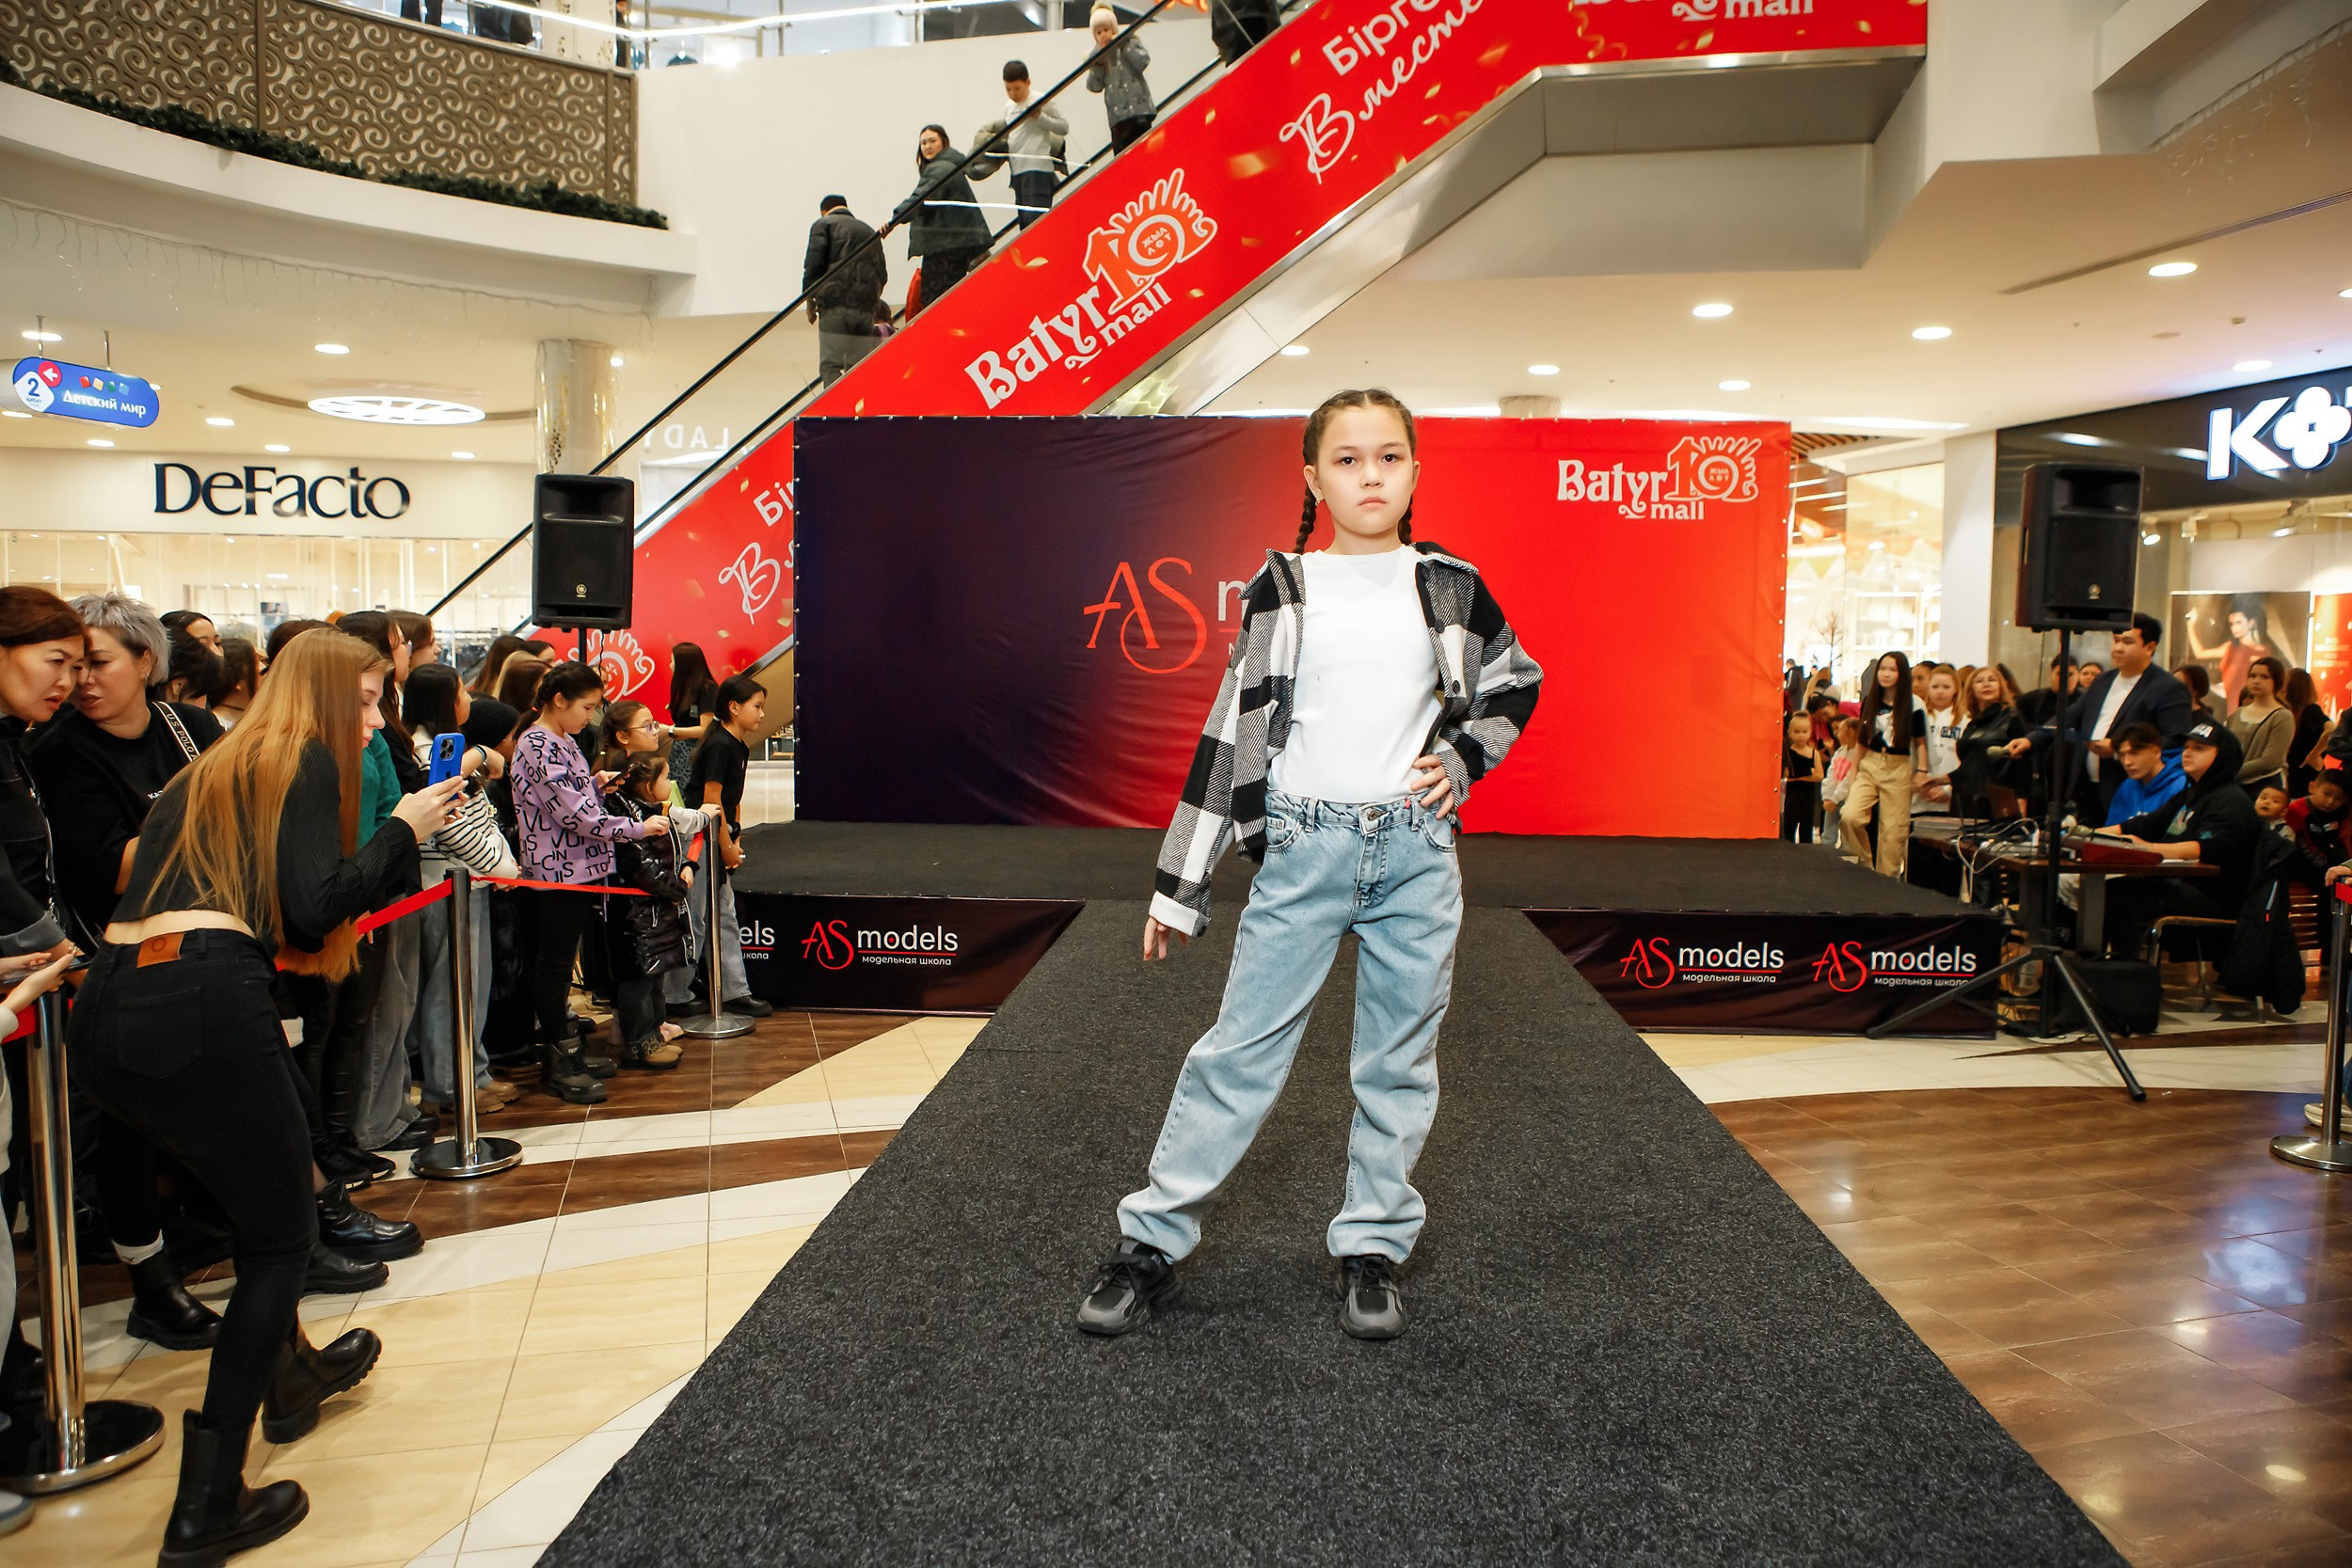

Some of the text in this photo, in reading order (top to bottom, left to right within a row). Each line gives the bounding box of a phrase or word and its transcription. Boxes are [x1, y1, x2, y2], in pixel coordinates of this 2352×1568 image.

[1099, 282, 1172, 347] mall
[964, 285, 1106, 410] Batyr
[27, 377, 40, 397] 2
[62, 389, 118, 411] Детский
[120, 402, 147, 419] мир
[153, 463, 411, 519] DeFacto
[1557, 459, 1668, 516] Batyr
[1650, 501, 1704, 520] mall
[1083, 557, 1208, 674] AS
[177, 730, 195, 752] POLO
[801, 919, 959, 970] AS models
[862, 956, 952, 966] модельная школа
[1619, 937, 1785, 989] AS models
[1812, 941, 1977, 992] AS models
[1682, 974, 1740, 984] модельная
[1873, 977, 1932, 987] модельная
